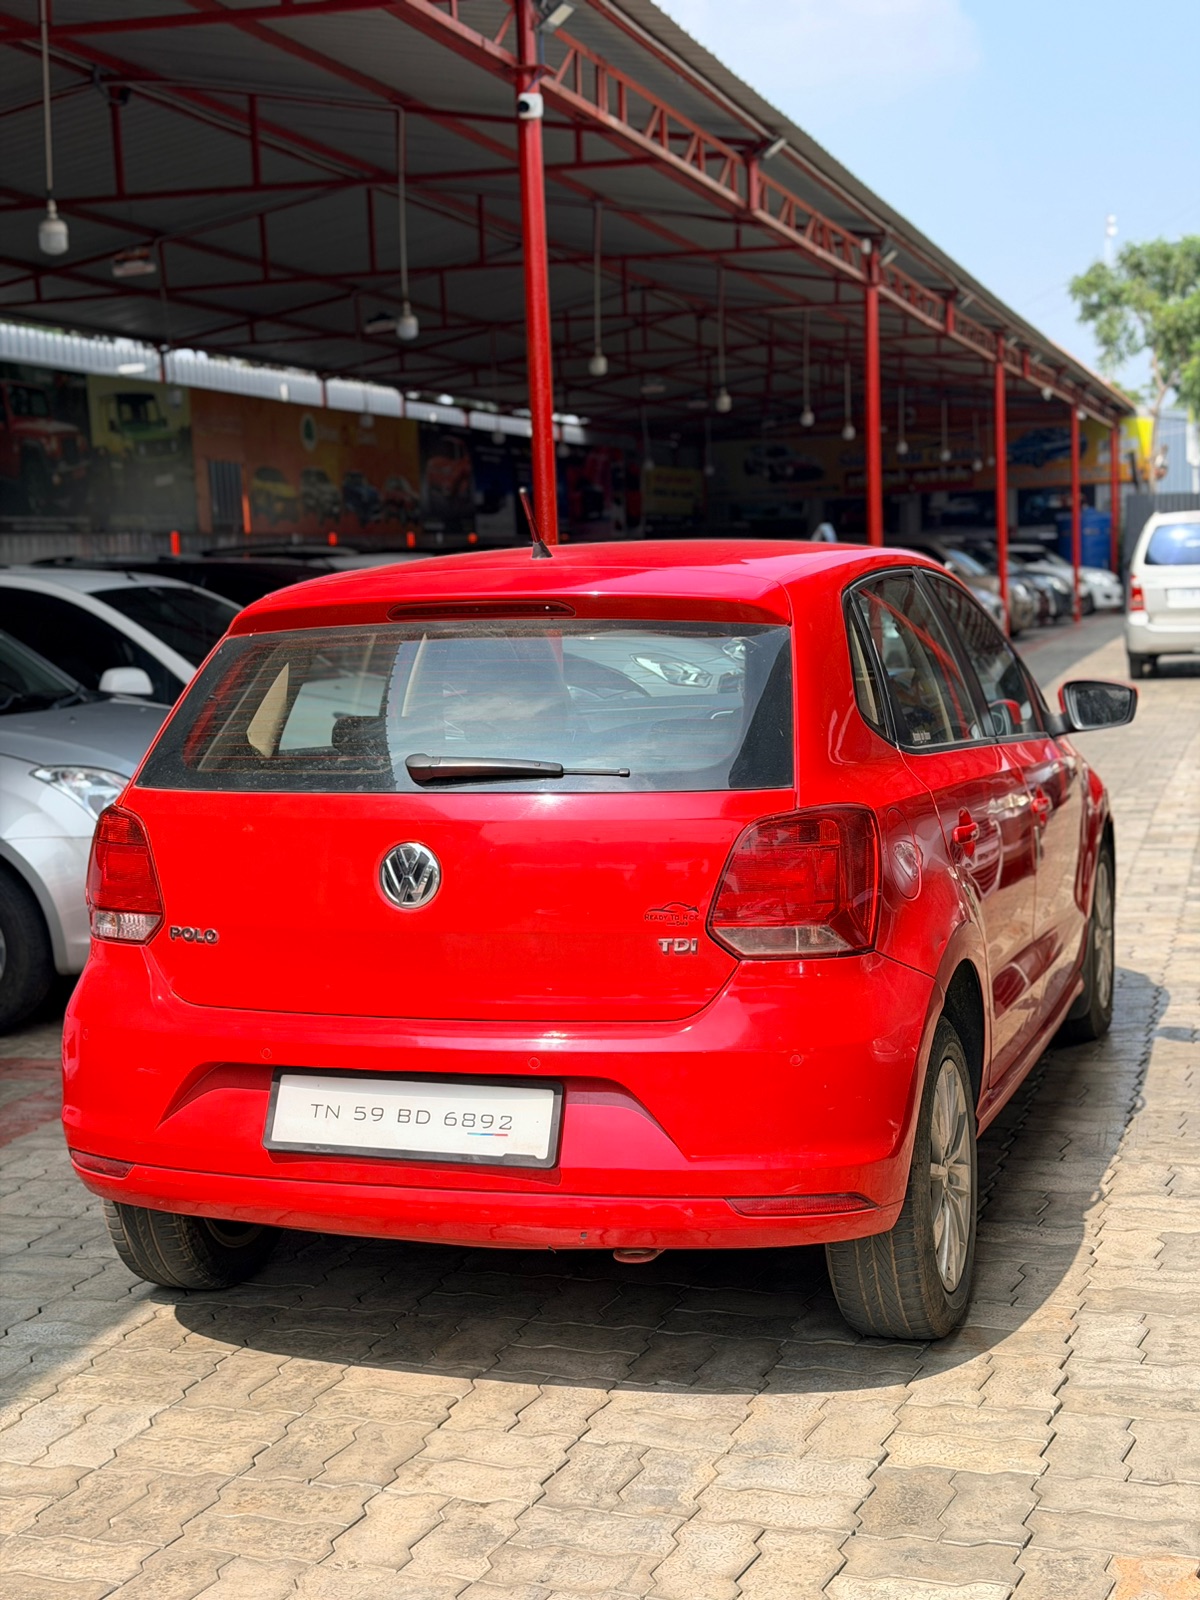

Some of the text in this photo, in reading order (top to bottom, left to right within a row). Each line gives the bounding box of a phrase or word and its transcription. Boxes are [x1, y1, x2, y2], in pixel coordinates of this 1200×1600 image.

[170, 926, 218, 945] POLO
[657, 938, 699, 955] TDI
[310, 1103, 514, 1131] TN 59 BD 6892
